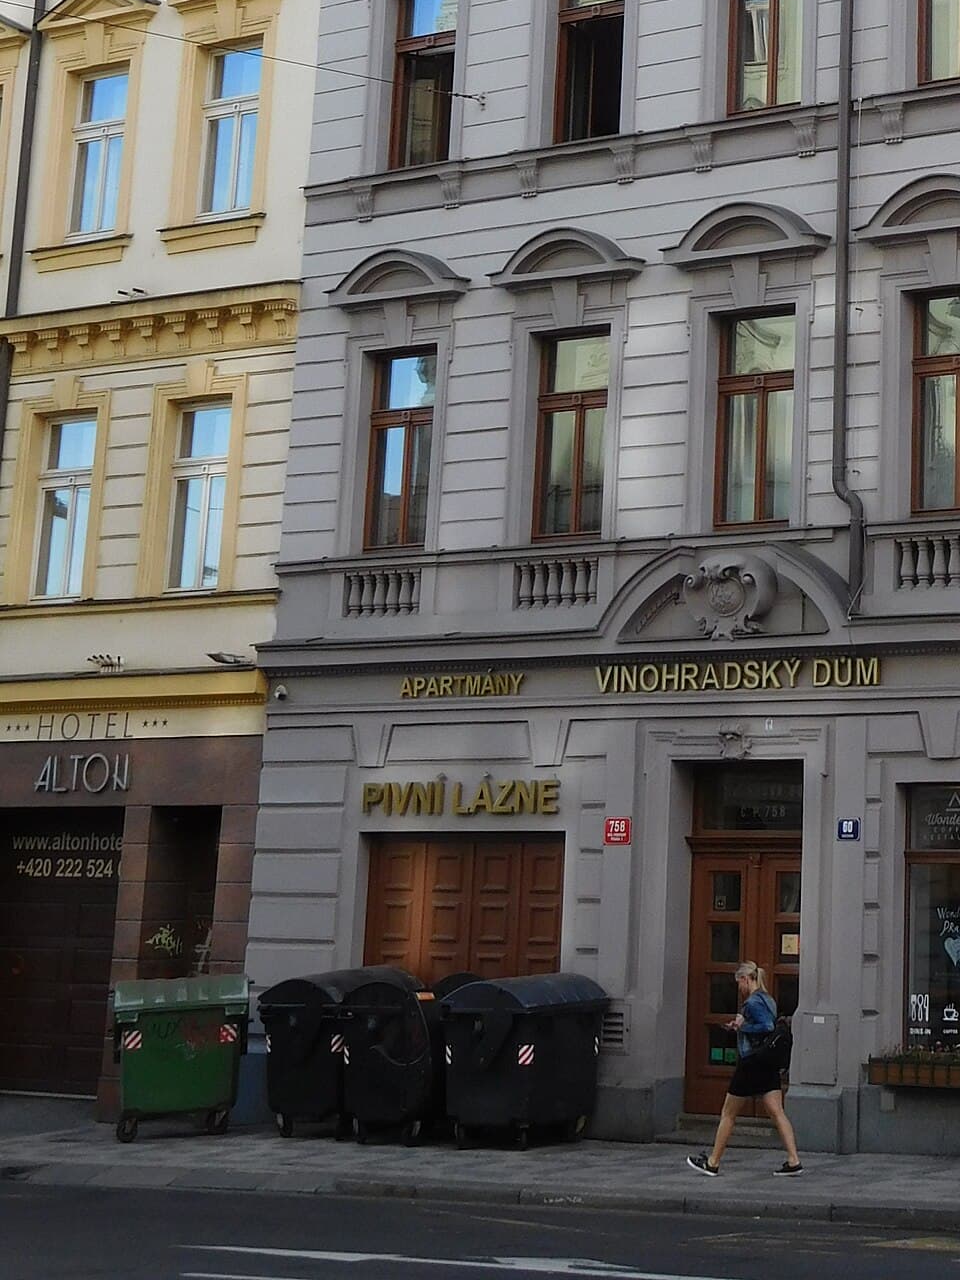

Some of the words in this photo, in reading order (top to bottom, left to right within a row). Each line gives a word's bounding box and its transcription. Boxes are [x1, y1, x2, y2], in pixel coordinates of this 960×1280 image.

[400, 669, 526, 697] APARTMÁNY
[595, 658, 801, 693] VINOHRADSKÝ
[812, 656, 880, 688] DŮM
[37, 712, 133, 740] HOTEL
[34, 753, 129, 793] ALTON
[362, 772, 449, 817] PIVNÍ
[609, 820, 626, 833] 758
[17, 858, 51, 877] +420
[55, 858, 82, 878] 222
[86, 859, 113, 878] 524
